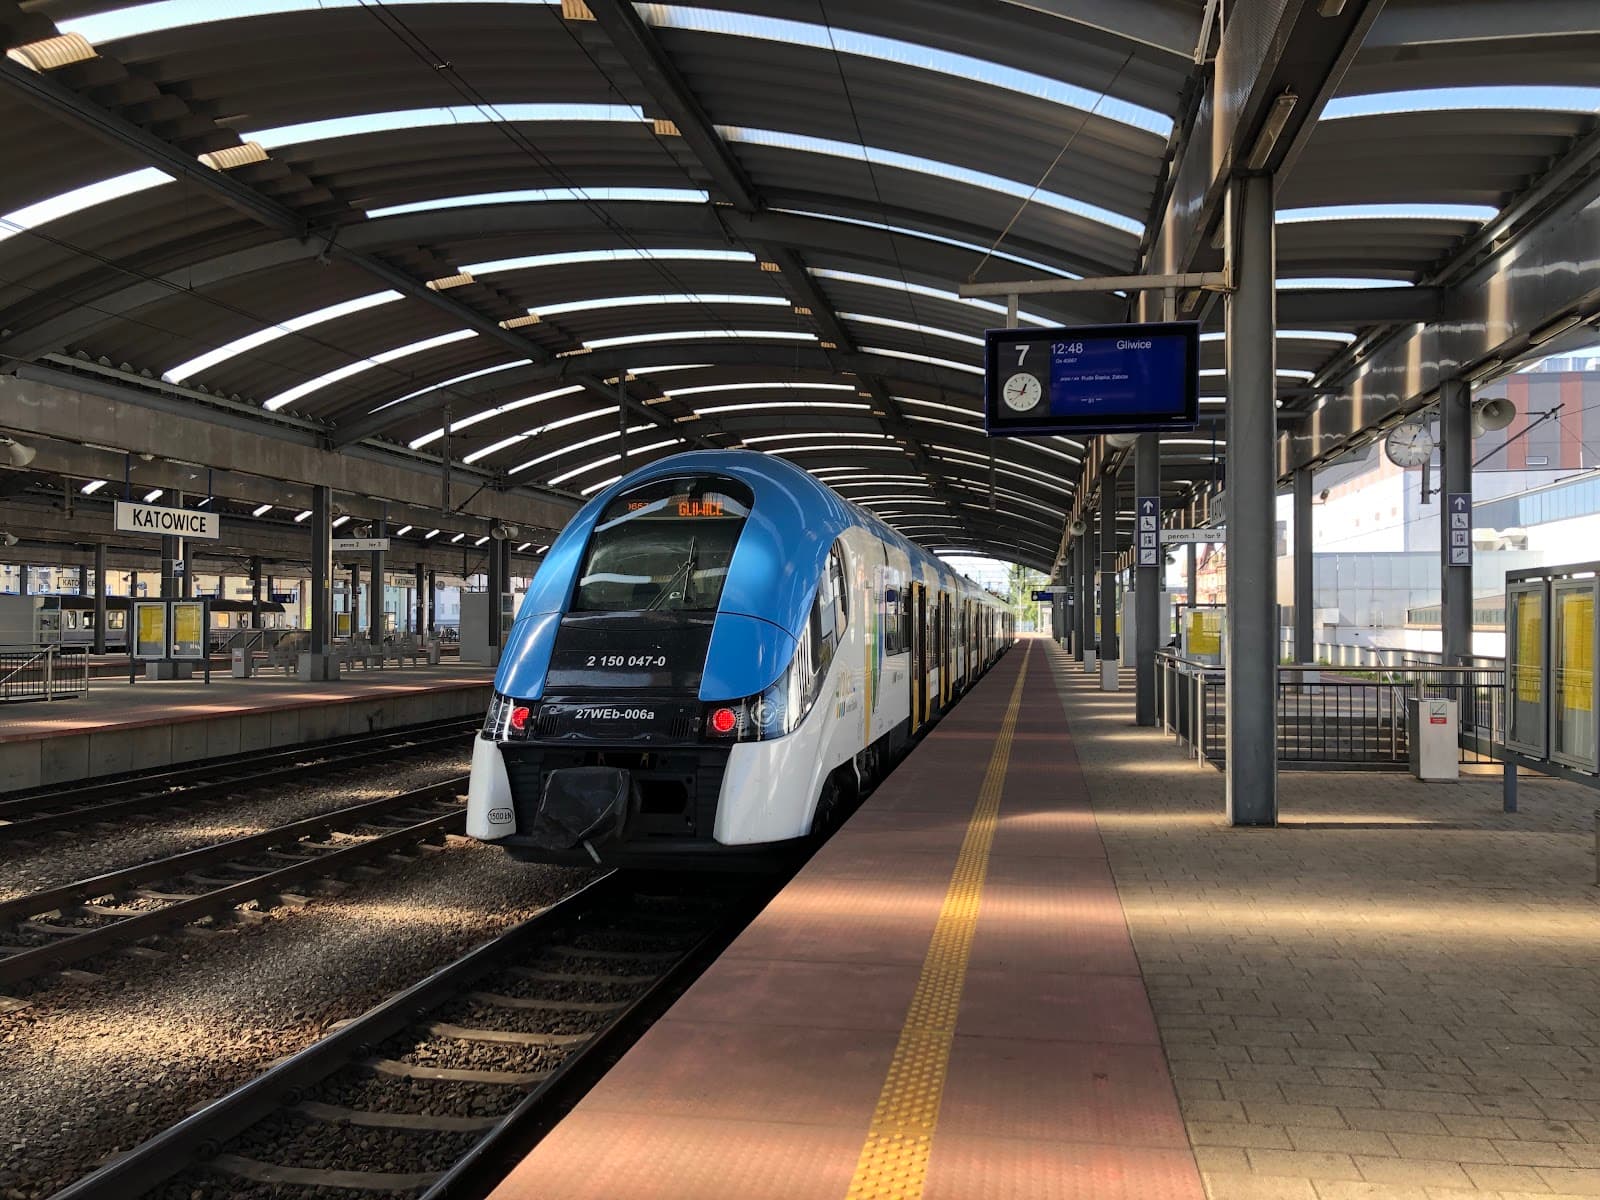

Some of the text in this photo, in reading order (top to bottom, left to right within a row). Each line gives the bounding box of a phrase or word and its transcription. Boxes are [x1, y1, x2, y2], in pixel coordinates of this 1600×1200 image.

[1051, 339, 1152, 355] 12:48 Gliwice
[1015, 344, 1031, 366] 7
[678, 502, 723, 517] GLIWICE
[132, 508, 207, 533] KATOWICE
[586, 655, 666, 667] 2 150 047-0
[575, 708, 655, 720] 27WEb-006a
